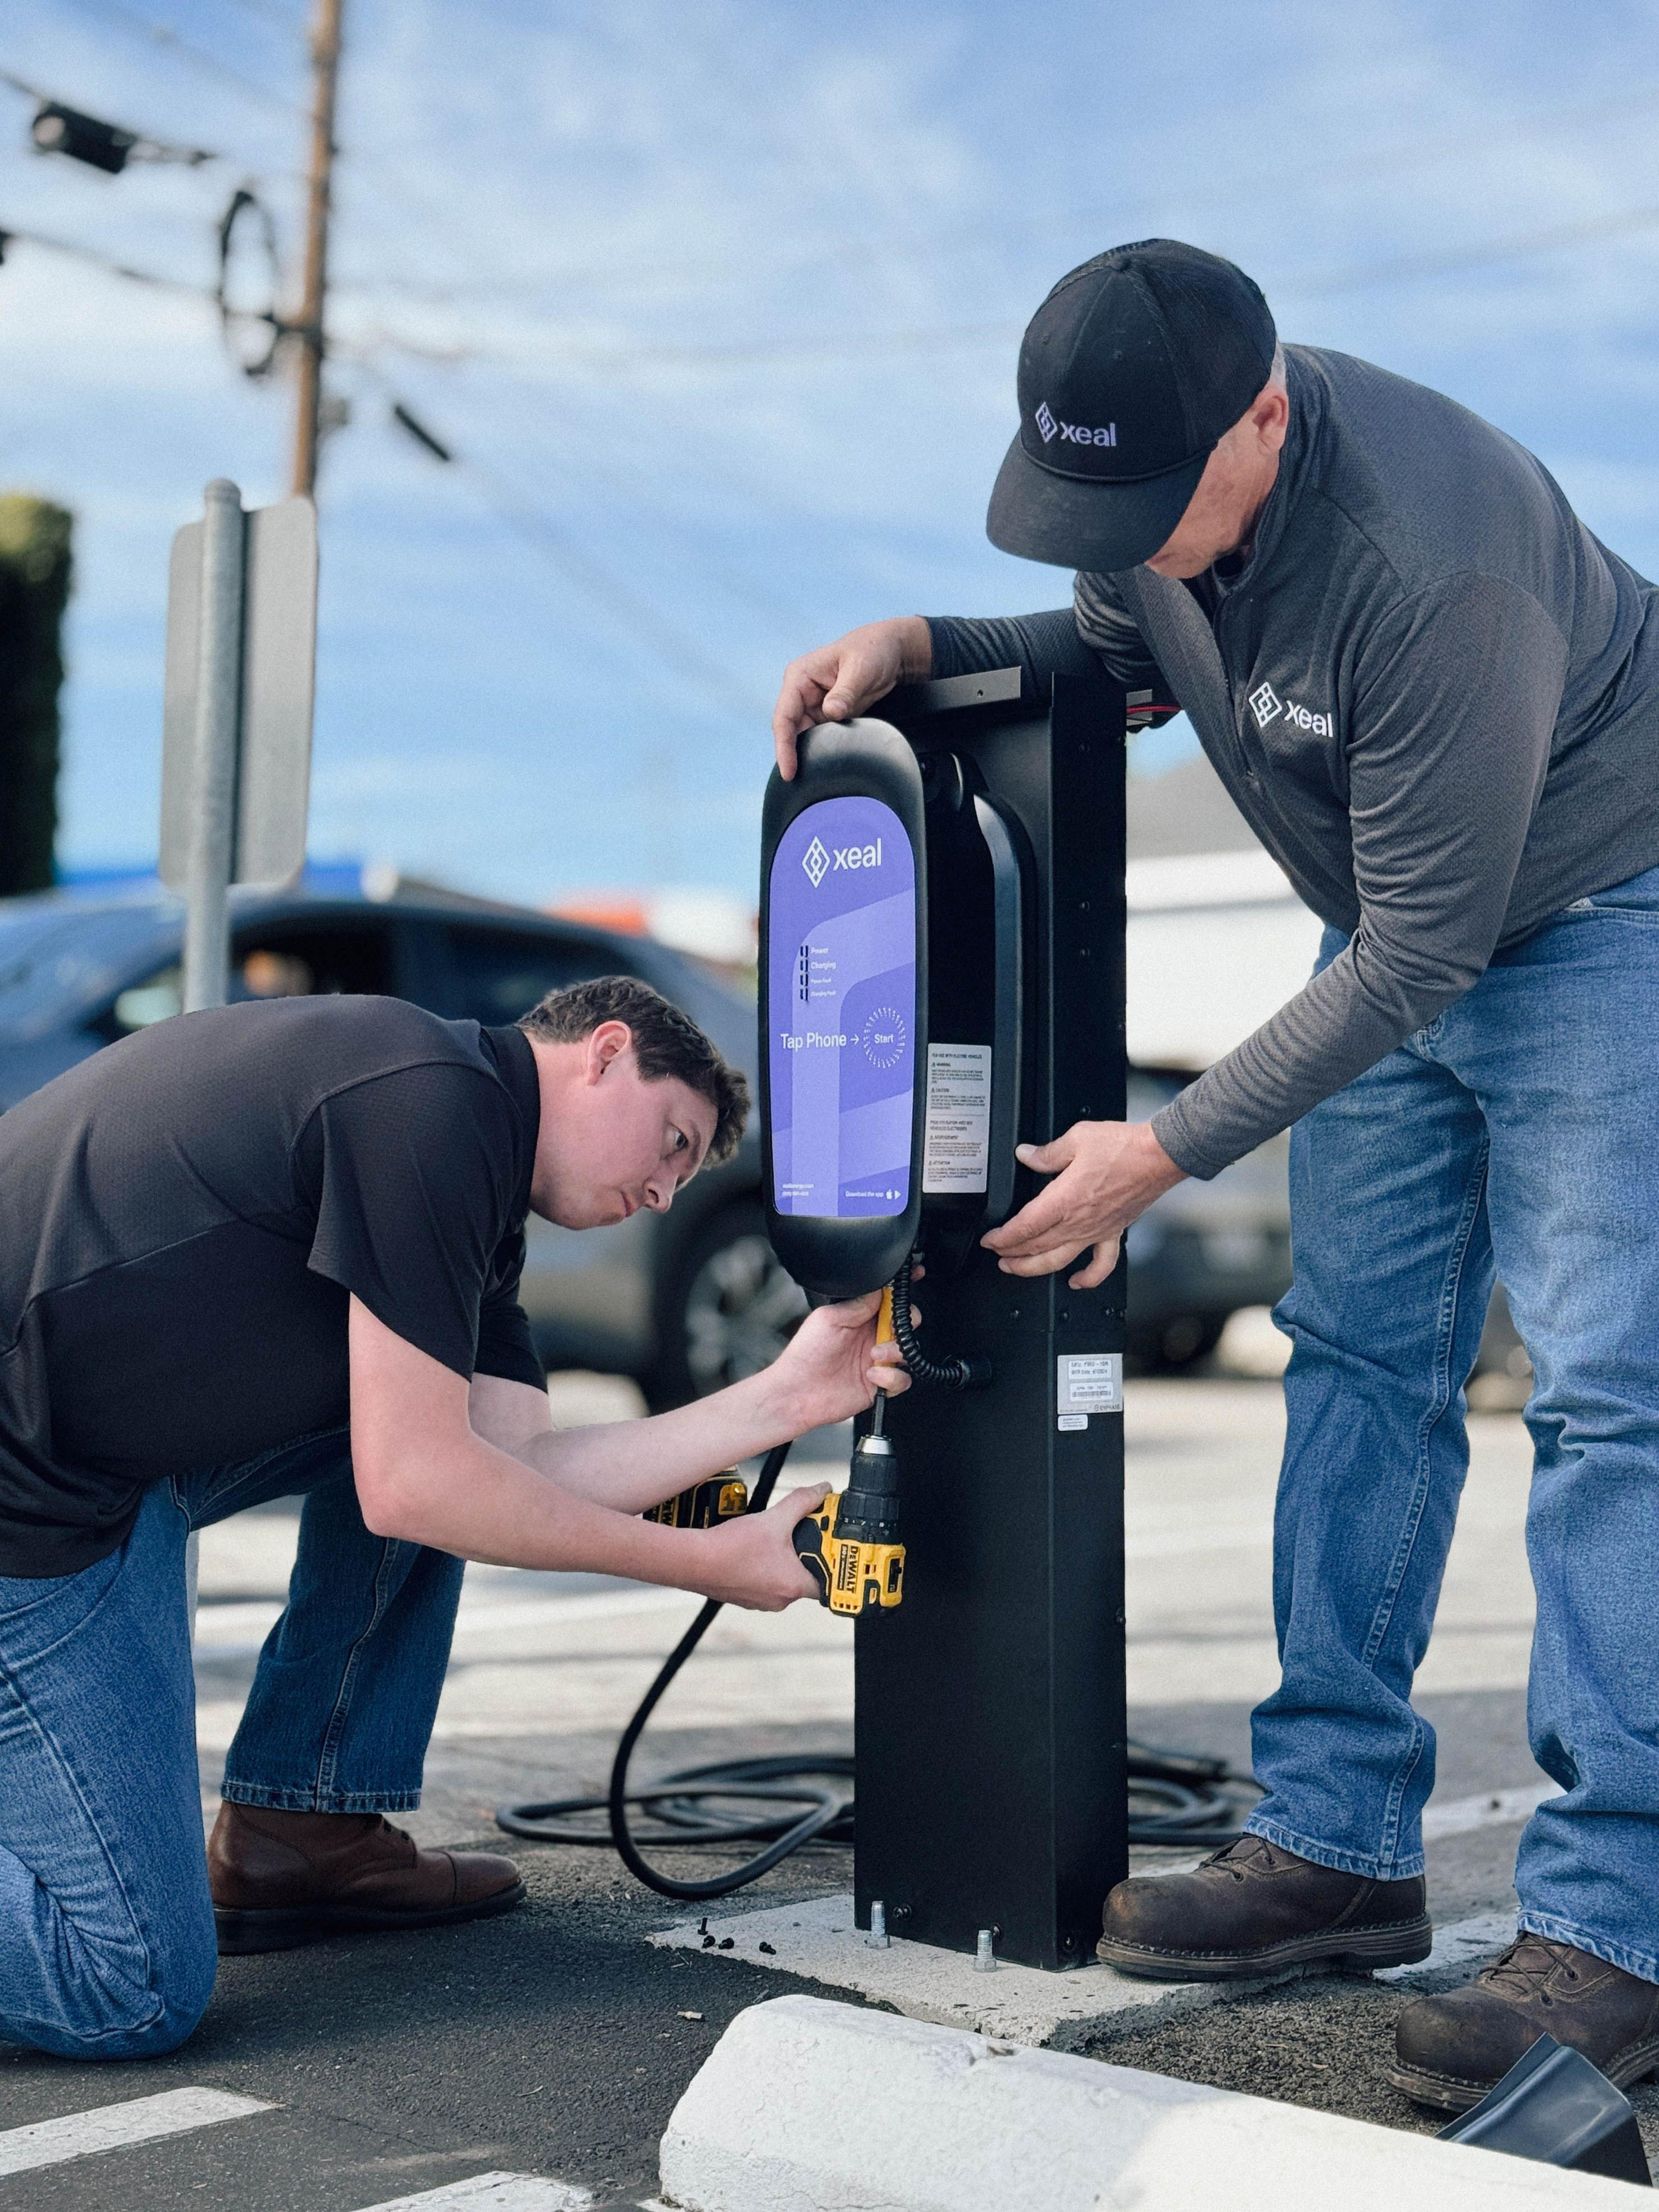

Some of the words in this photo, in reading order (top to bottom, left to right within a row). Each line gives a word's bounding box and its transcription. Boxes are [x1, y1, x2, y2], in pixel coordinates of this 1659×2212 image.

[1059, 422, 1117, 446] xeal
[1284, 700, 1333, 737] xeal
[833, 838, 882, 871] xeal
[811, 961, 836, 970] Charging
[780, 1033, 804, 1052] Tap
[807, 1032, 847, 1048] Phone
[874, 1033, 894, 1044] Start
[846, 1545, 858, 1594] DEWALT
